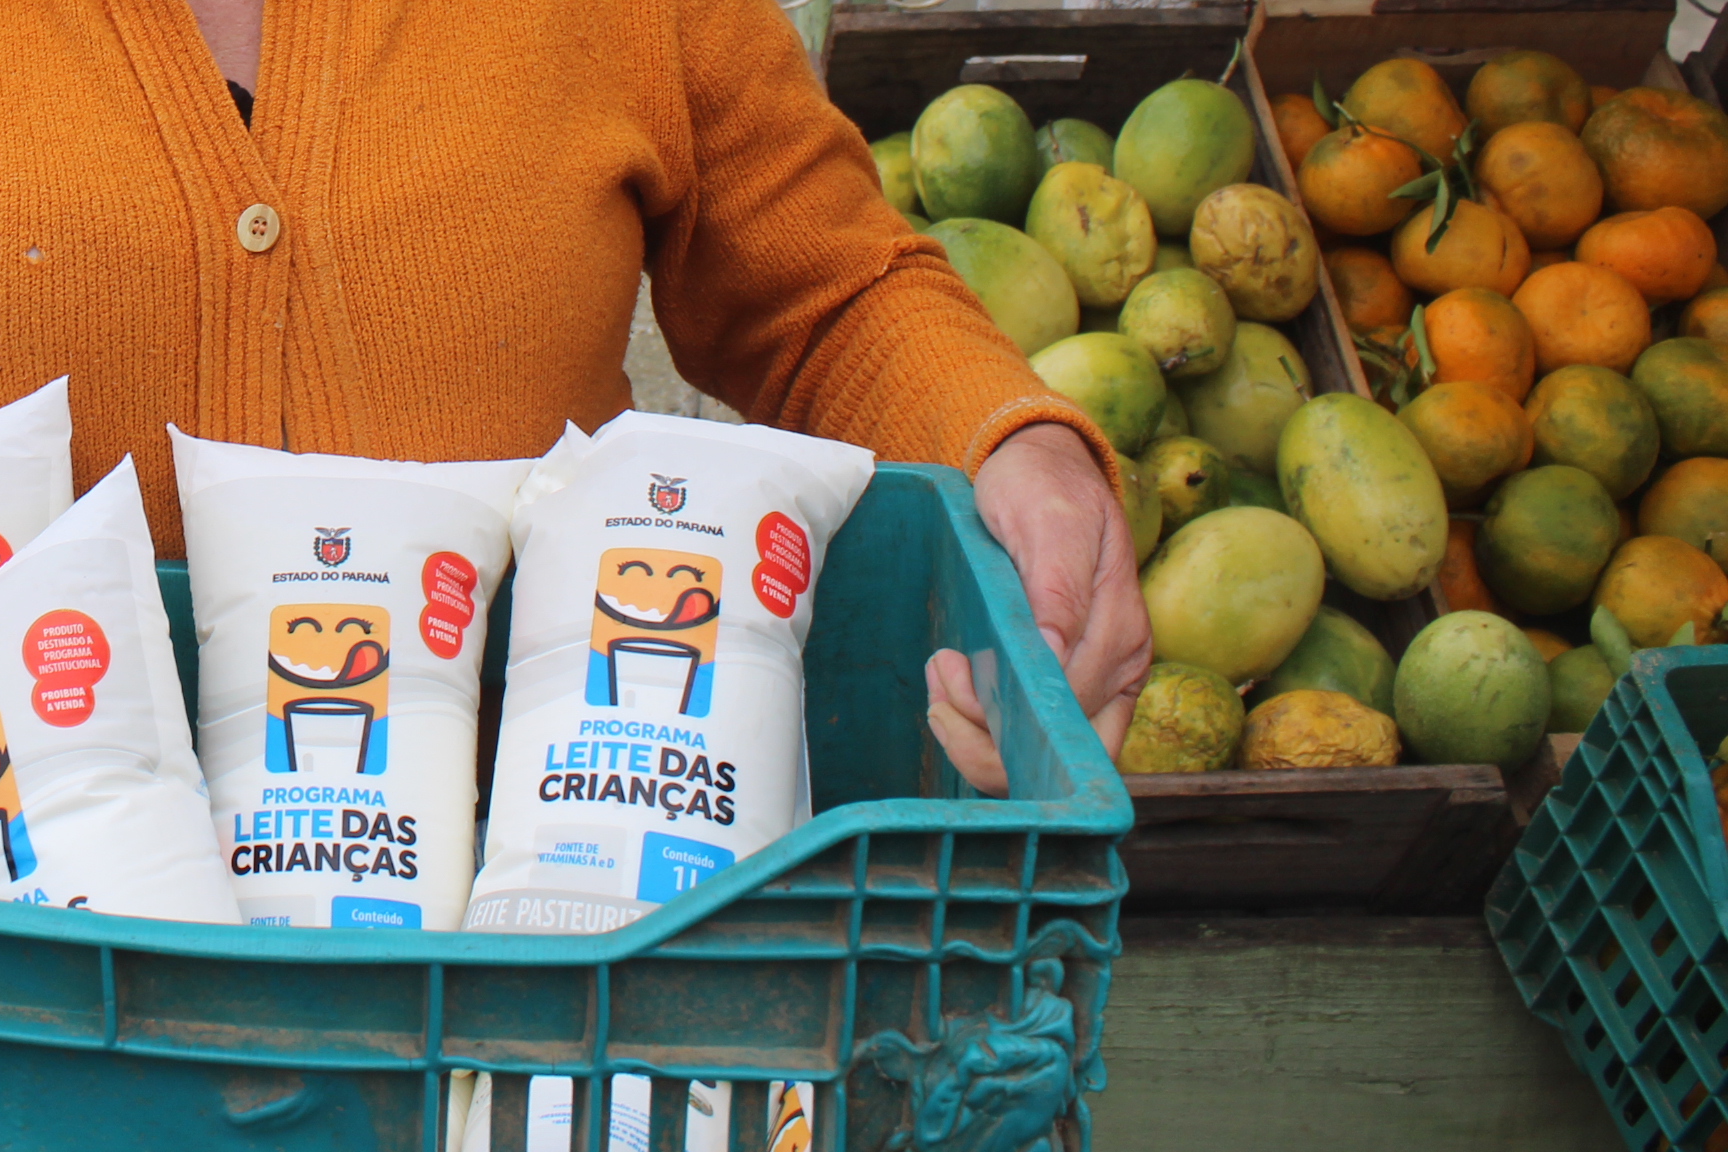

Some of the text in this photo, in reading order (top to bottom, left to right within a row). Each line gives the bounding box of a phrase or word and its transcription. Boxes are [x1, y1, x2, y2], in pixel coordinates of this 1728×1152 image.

[606, 517, 724, 537] ESTADO DO PARANÁ
[777, 522, 802, 546] PRODUTO
[770, 530, 802, 556] DESTINADO
[772, 542, 802, 569] PROGRAMA
[440, 561, 468, 581] PRODUTO
[765, 550, 805, 584] INSTITUCIONAL
[273, 572, 390, 584] ESTADO DO PARANÁ
[761, 573, 791, 597] PROIBIDA
[431, 591, 470, 615] INSTITUCIONAL
[769, 587, 789, 606] VENDA
[43, 624, 84, 636] PRODUTO
[428, 616, 458, 634] PROIBIDA
[38, 636, 93, 650] DESTINADO A
[436, 630, 456, 645] VENDA
[44, 647, 92, 661] PROGRAMA
[39, 659, 102, 675] INSTITUCIONAL
[41, 687, 85, 701] PROIBIDA
[47, 699, 85, 712] A VENDA
[579, 720, 707, 750] PROGRAMA
[545, 741, 736, 792] LEITE DAS
[263, 787, 386, 807] PROGRAMA
[539, 773, 734, 826] CRIANÇAS
[235, 809, 416, 846] LEITE DAS
[555, 843, 599, 854] FONTE DE
[662, 847, 715, 869] Conteúdo
[231, 842, 418, 882] CRIANÇAS
[537, 853, 588, 866] VITAMINAS
[590, 856, 596, 866] A
[607, 858, 614, 868] D
[352, 909, 403, 925] Conteúdo
[467, 898, 510, 929] LEITE
